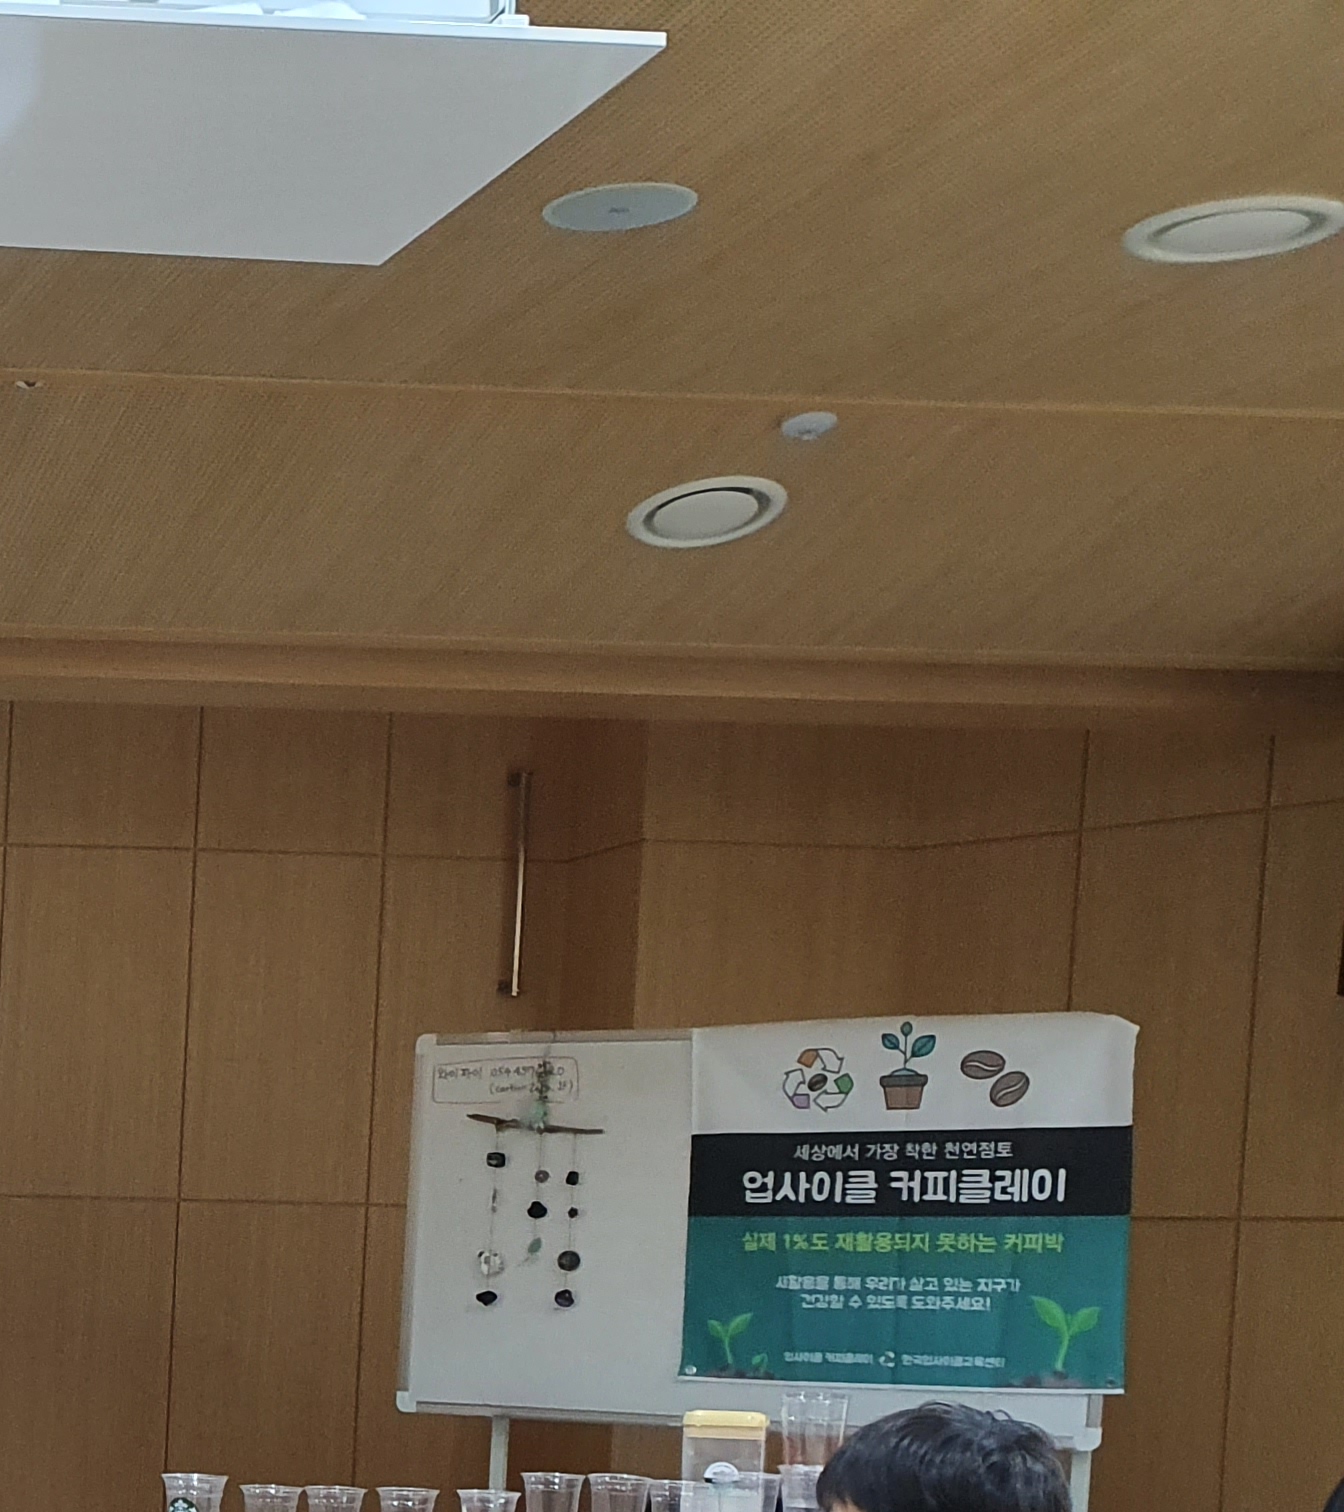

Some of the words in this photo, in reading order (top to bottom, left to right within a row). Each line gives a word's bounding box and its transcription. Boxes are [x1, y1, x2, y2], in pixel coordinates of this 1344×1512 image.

[794, 1144, 859, 1161] 세상에서
[866, 1143, 899, 1160] 가장
[906, 1142, 937, 1160] 착한
[944, 1141, 1013, 1159] 천연점토
[743, 1170, 878, 1204] 업사이클
[889, 1168, 1067, 1204] 커피클레이
[742, 1232, 776, 1252] 실제
[783, 1232, 829, 1251] 1%도
[836, 1231, 929, 1252] 재활용되지
[936, 1232, 997, 1252] 못하는
[1004, 1231, 1064, 1253] 커피박
[977, 1278, 1021, 1293] 지구가
[911, 1295, 991, 1311] 도와주세요!
